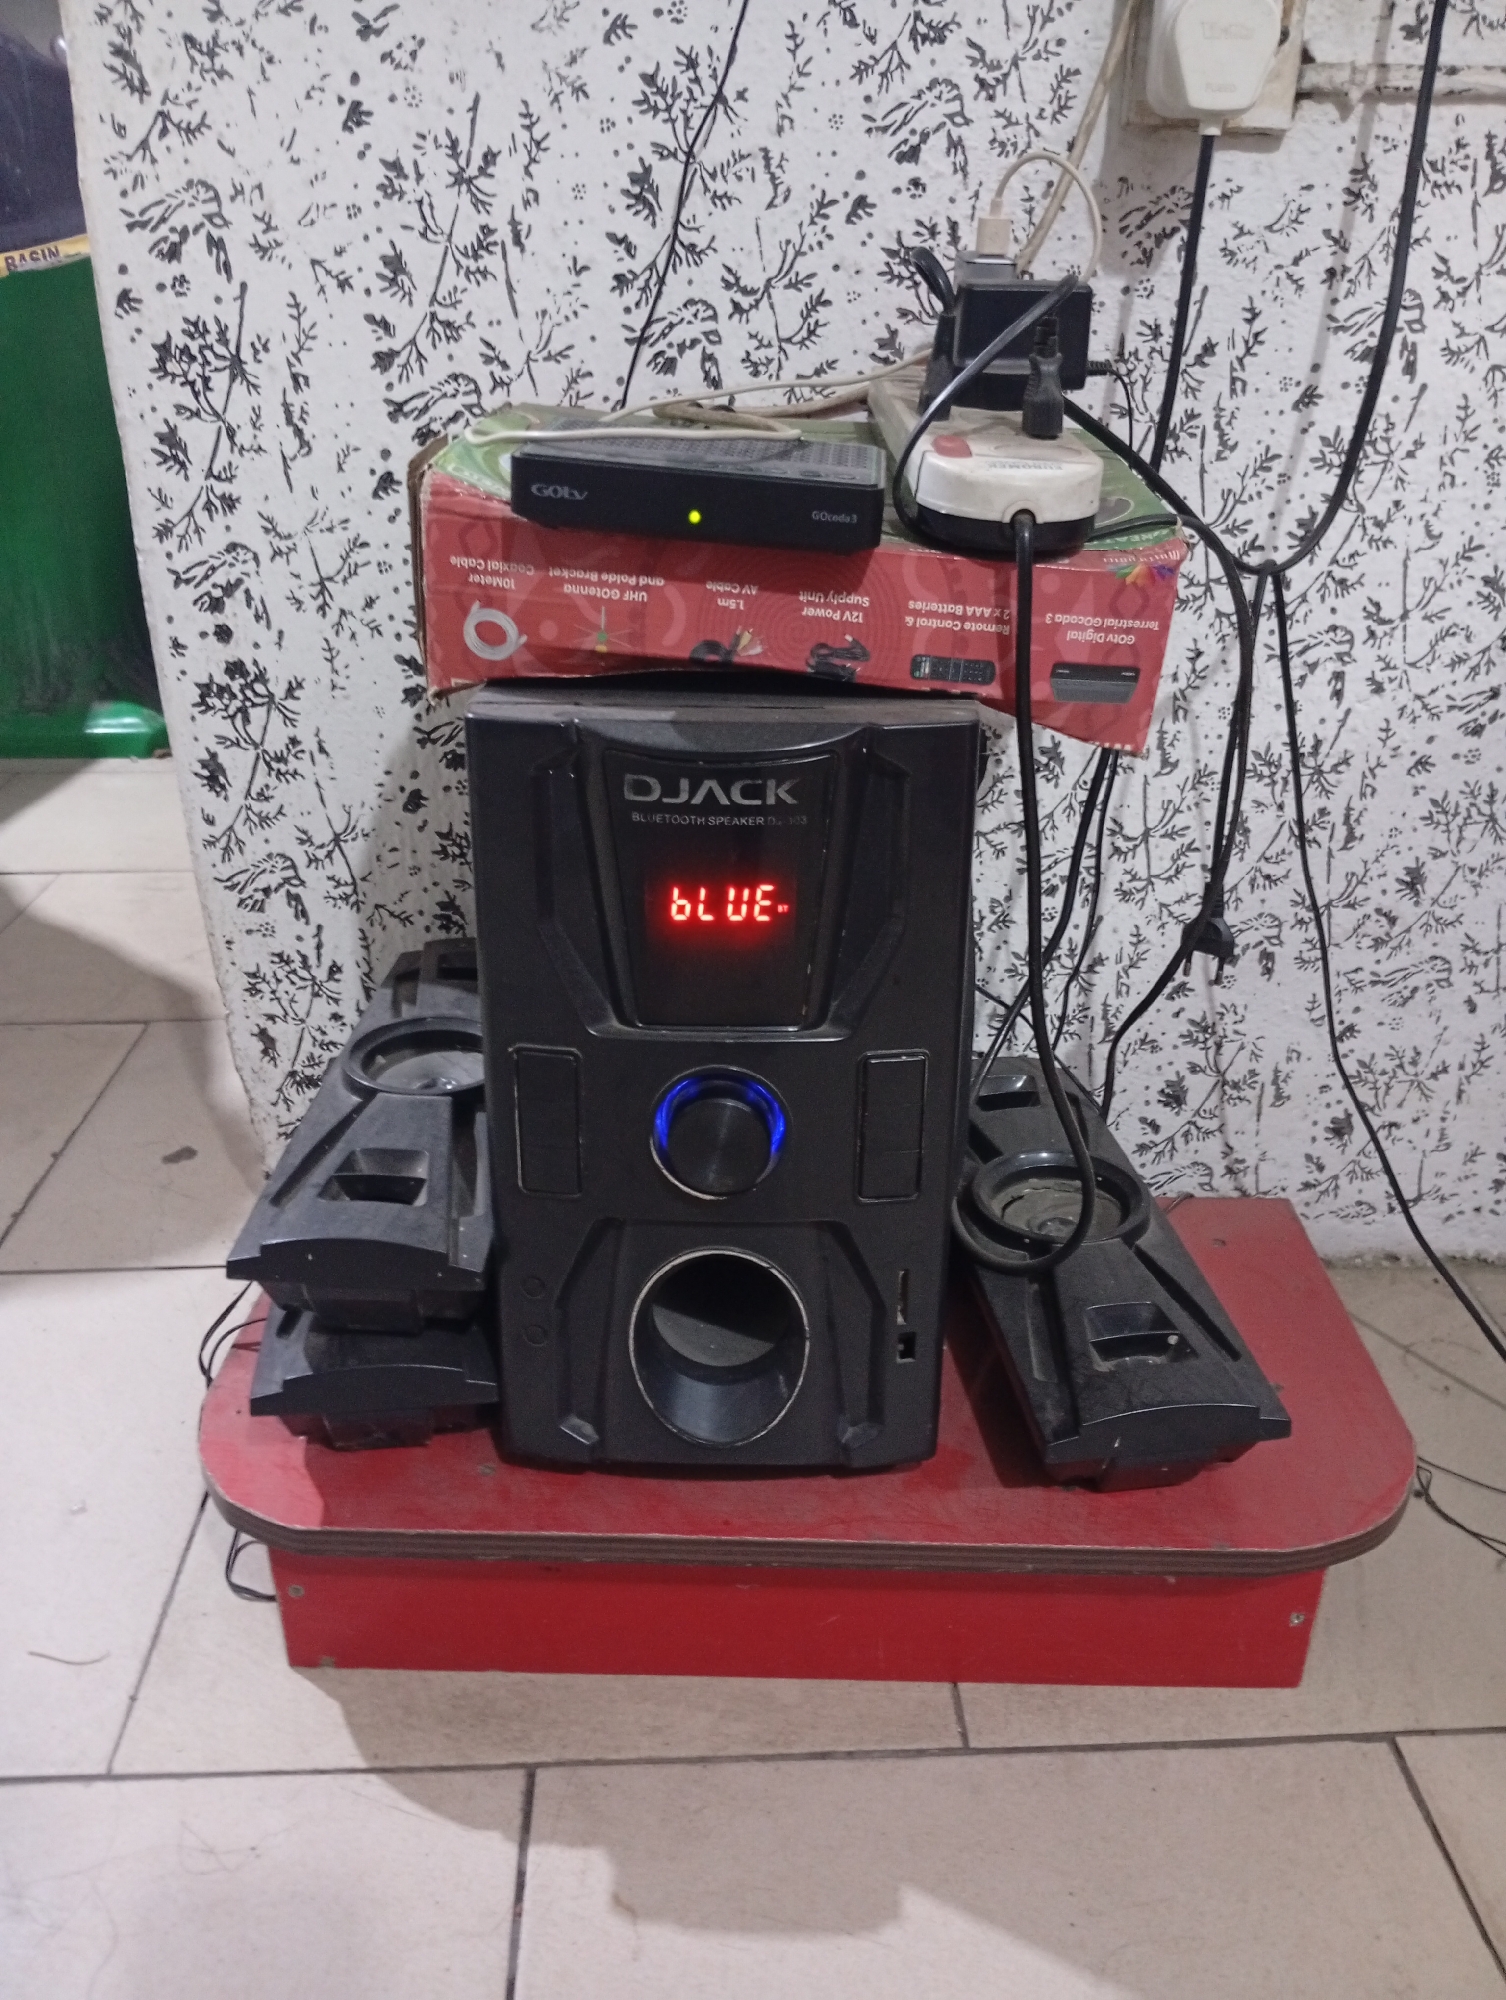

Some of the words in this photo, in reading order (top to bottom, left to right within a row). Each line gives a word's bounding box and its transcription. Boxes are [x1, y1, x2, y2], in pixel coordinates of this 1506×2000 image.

[450, 555, 485, 570] Cable
[487, 561, 535, 576] Coaxial
[468, 573, 515, 590] 10Meter
[548, 566, 599, 583] Bracket
[638, 574, 665, 587] and
[563, 583, 621, 600] GOtenna
[706, 580, 740, 594] Cable
[741, 585, 759, 596] AV
[622, 590, 648, 602] UHF
[798, 590, 824, 603] Unit
[827, 589, 870, 607] Supply
[717, 597, 745, 611] 1.5m
[908, 599, 964, 616] Batteries
[801, 606, 840, 621] Power
[842, 611, 864, 624] 12V
[966, 606, 991, 618] AAA
[993, 609, 1001, 618] x
[1002, 608, 1010, 620] 2
[1045, 613, 1052, 624] 3
[904, 616, 914, 627] &
[916, 616, 961, 631] Control
[962, 620, 1010, 636] Remote
[1054, 614, 1102, 628] GOcoda
[1104, 618, 1160, 631] Terrestrial
[1066, 629, 1105, 644] Digital
[1106, 631, 1135, 645] GOtv
[624, 773, 800, 805] DJACK
[631, 811, 705, 826] BLUETOOTH
[707, 816, 765, 826] SPEAKER
